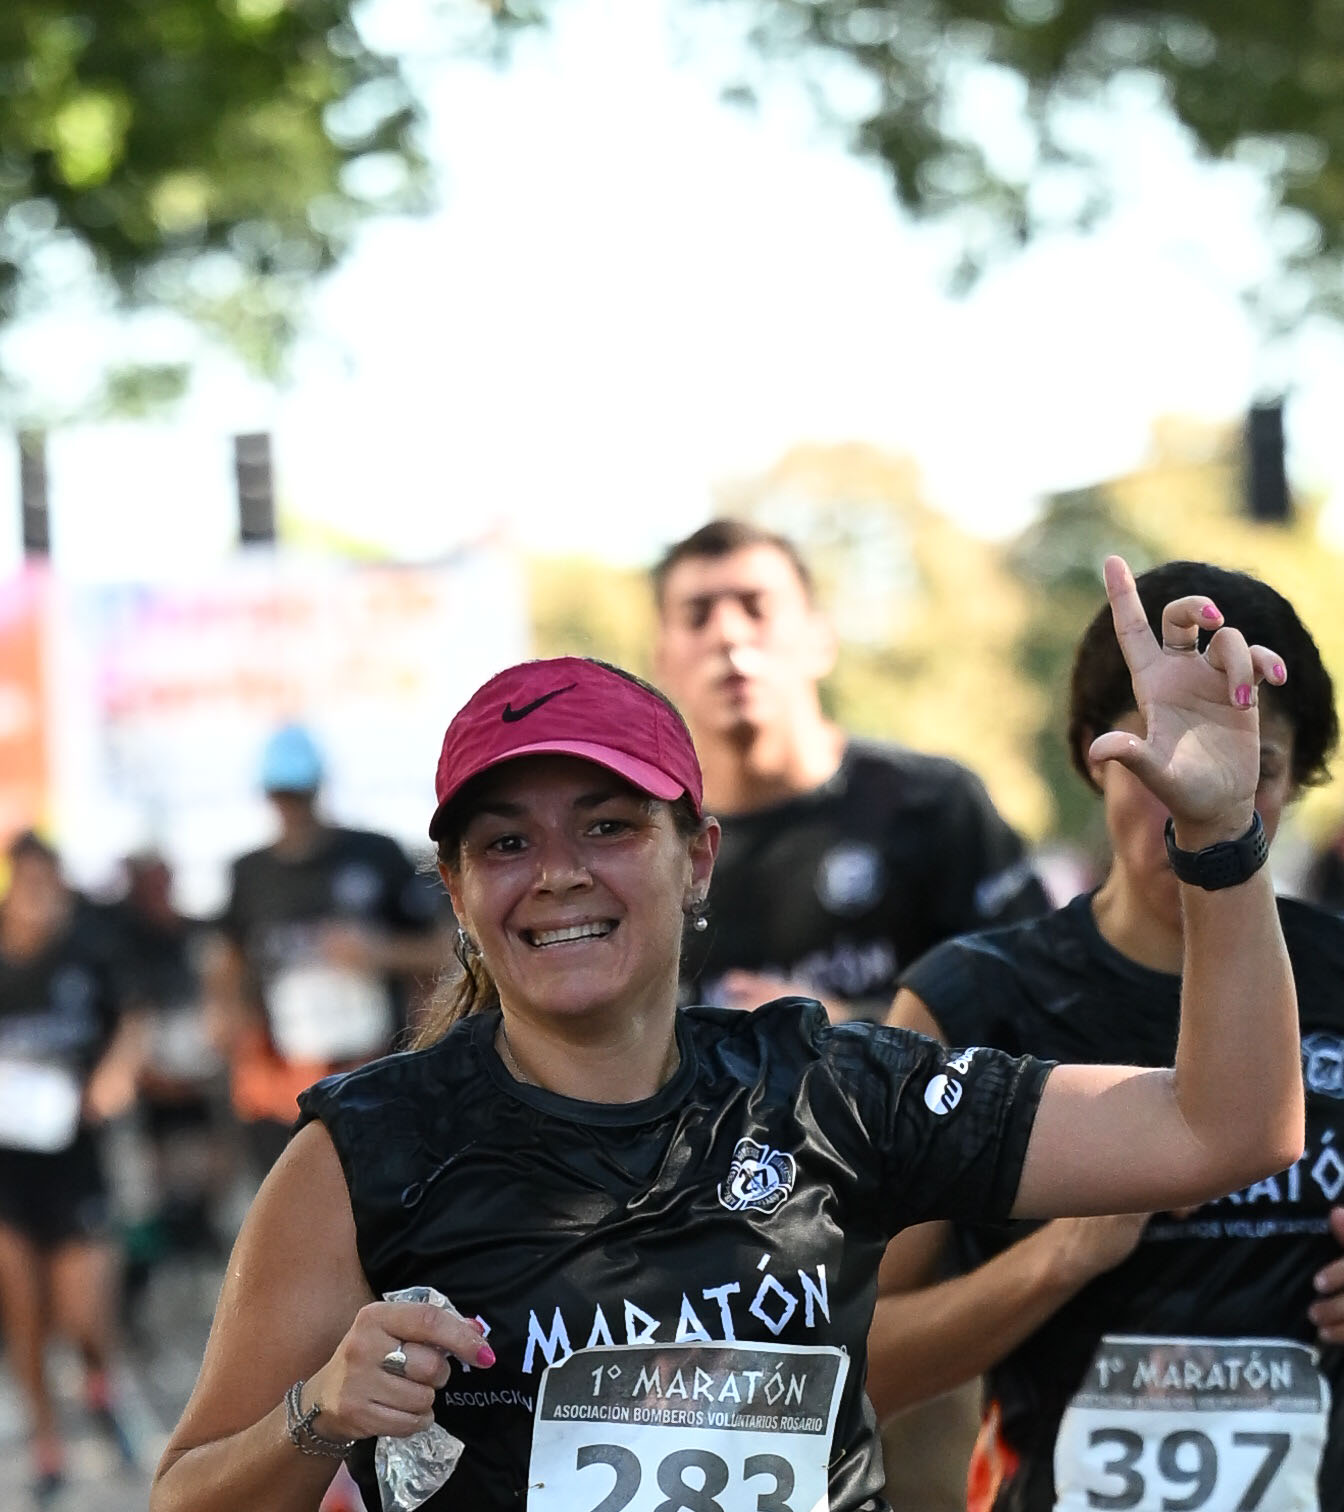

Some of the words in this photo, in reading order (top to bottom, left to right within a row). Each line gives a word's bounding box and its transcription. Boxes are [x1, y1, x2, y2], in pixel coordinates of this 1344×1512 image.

[632, 1361, 808, 1406] MARATÓN
[1132, 1351, 1292, 1391] MARATÓN
[553, 1402, 630, 1422] ASOCIACIÓN
[633, 1408, 704, 1426] BOMBEROS
[707, 1411, 778, 1430] VOLUNTARIOS
[779, 1415, 824, 1432] ROSARIO
